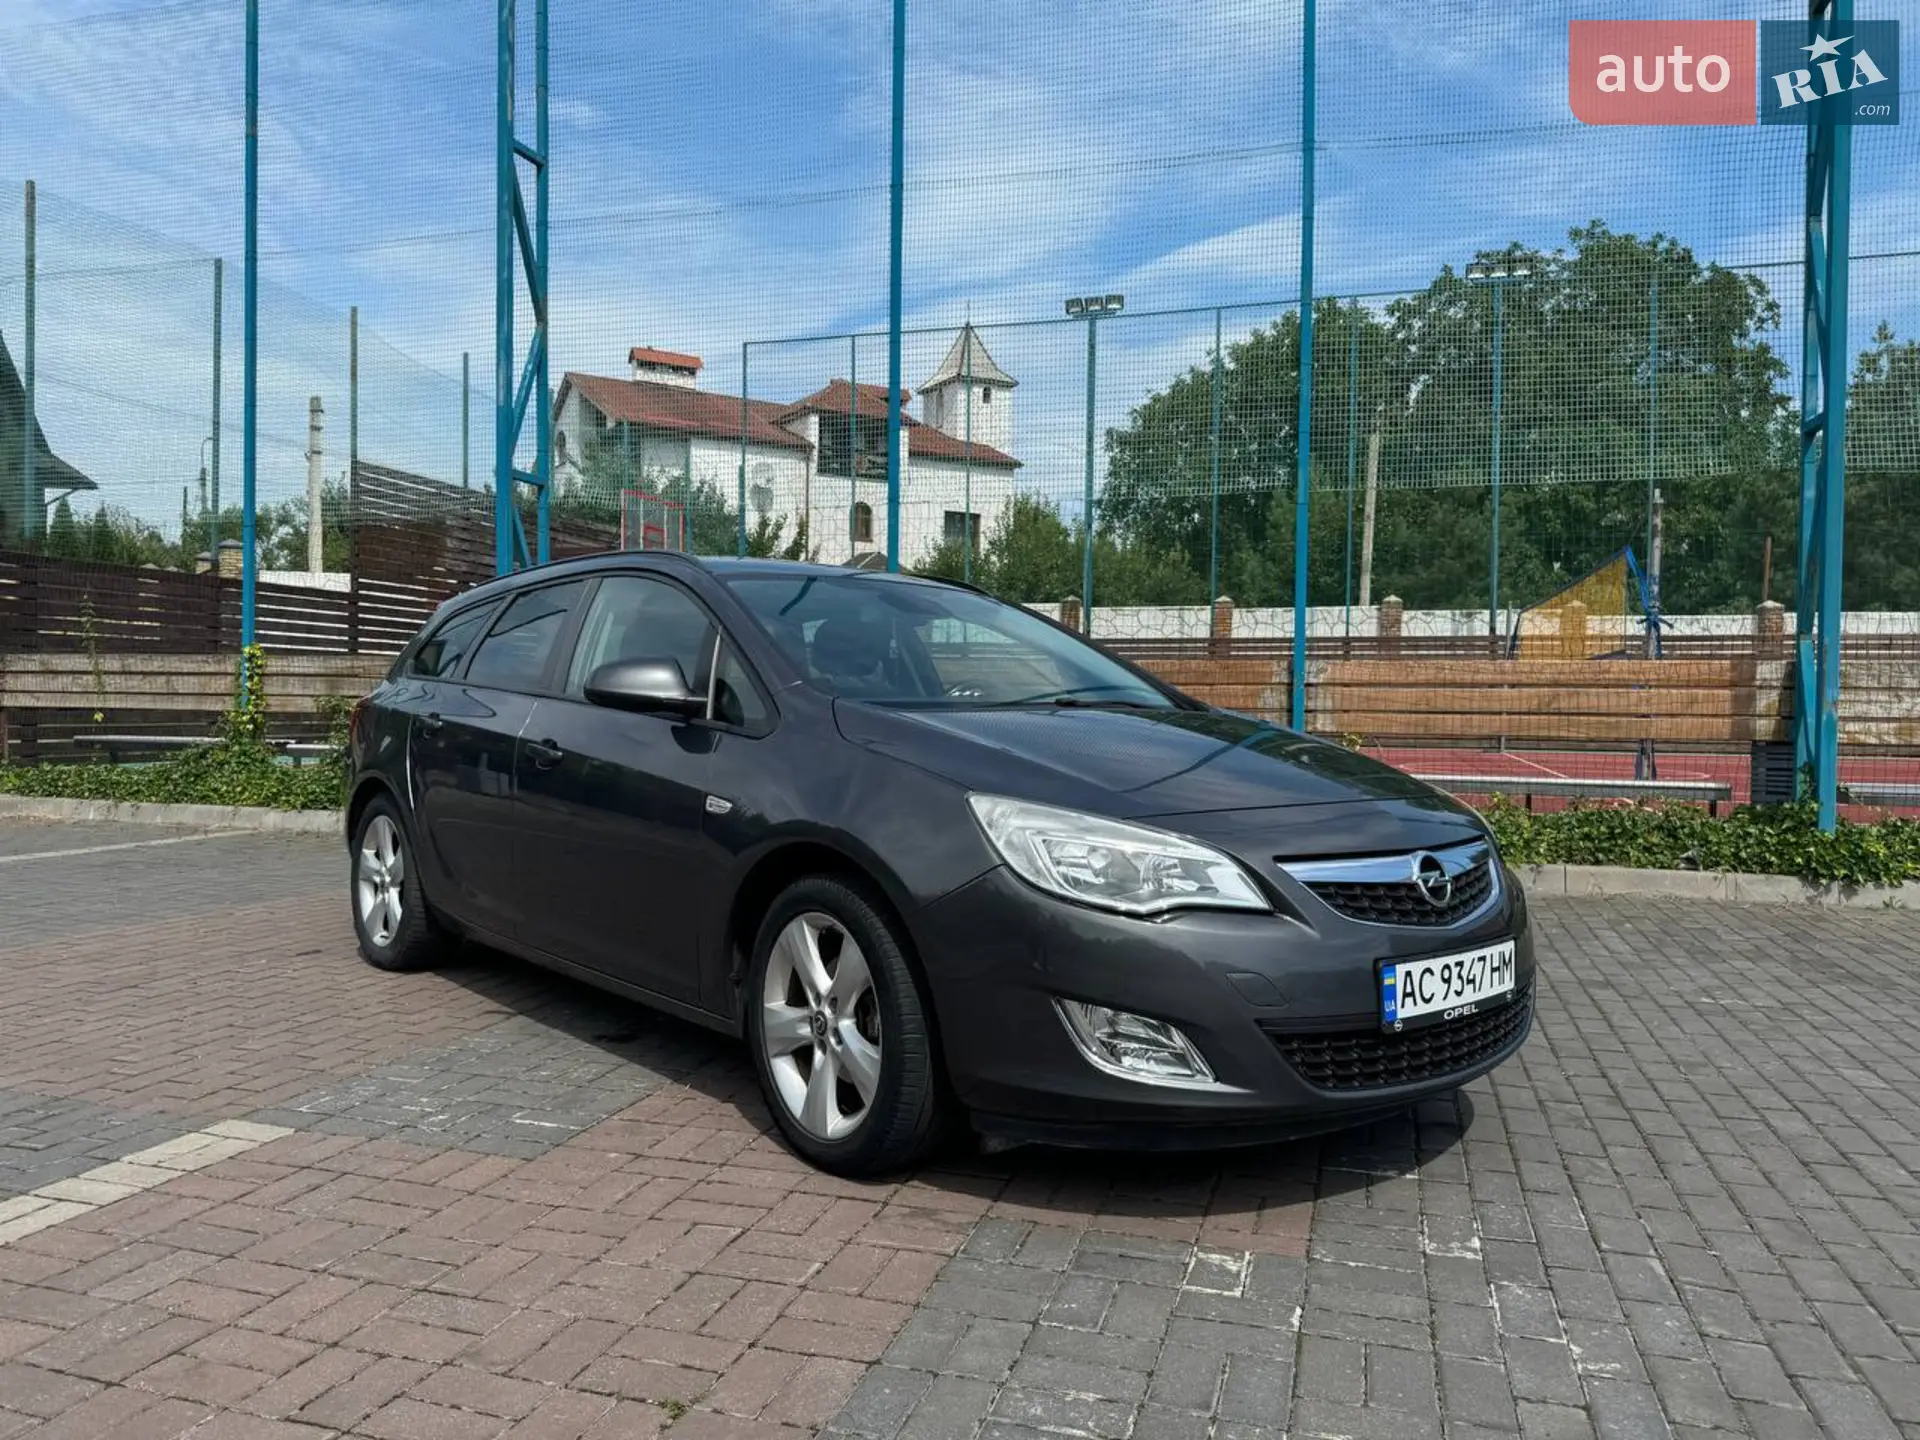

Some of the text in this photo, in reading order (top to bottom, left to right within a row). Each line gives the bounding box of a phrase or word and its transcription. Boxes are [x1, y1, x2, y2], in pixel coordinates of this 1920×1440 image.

[1400, 947, 1513, 1010] AC 9347 HM
[1384, 1000, 1396, 1012] UA
[1443, 1003, 1479, 1020] OPEL
